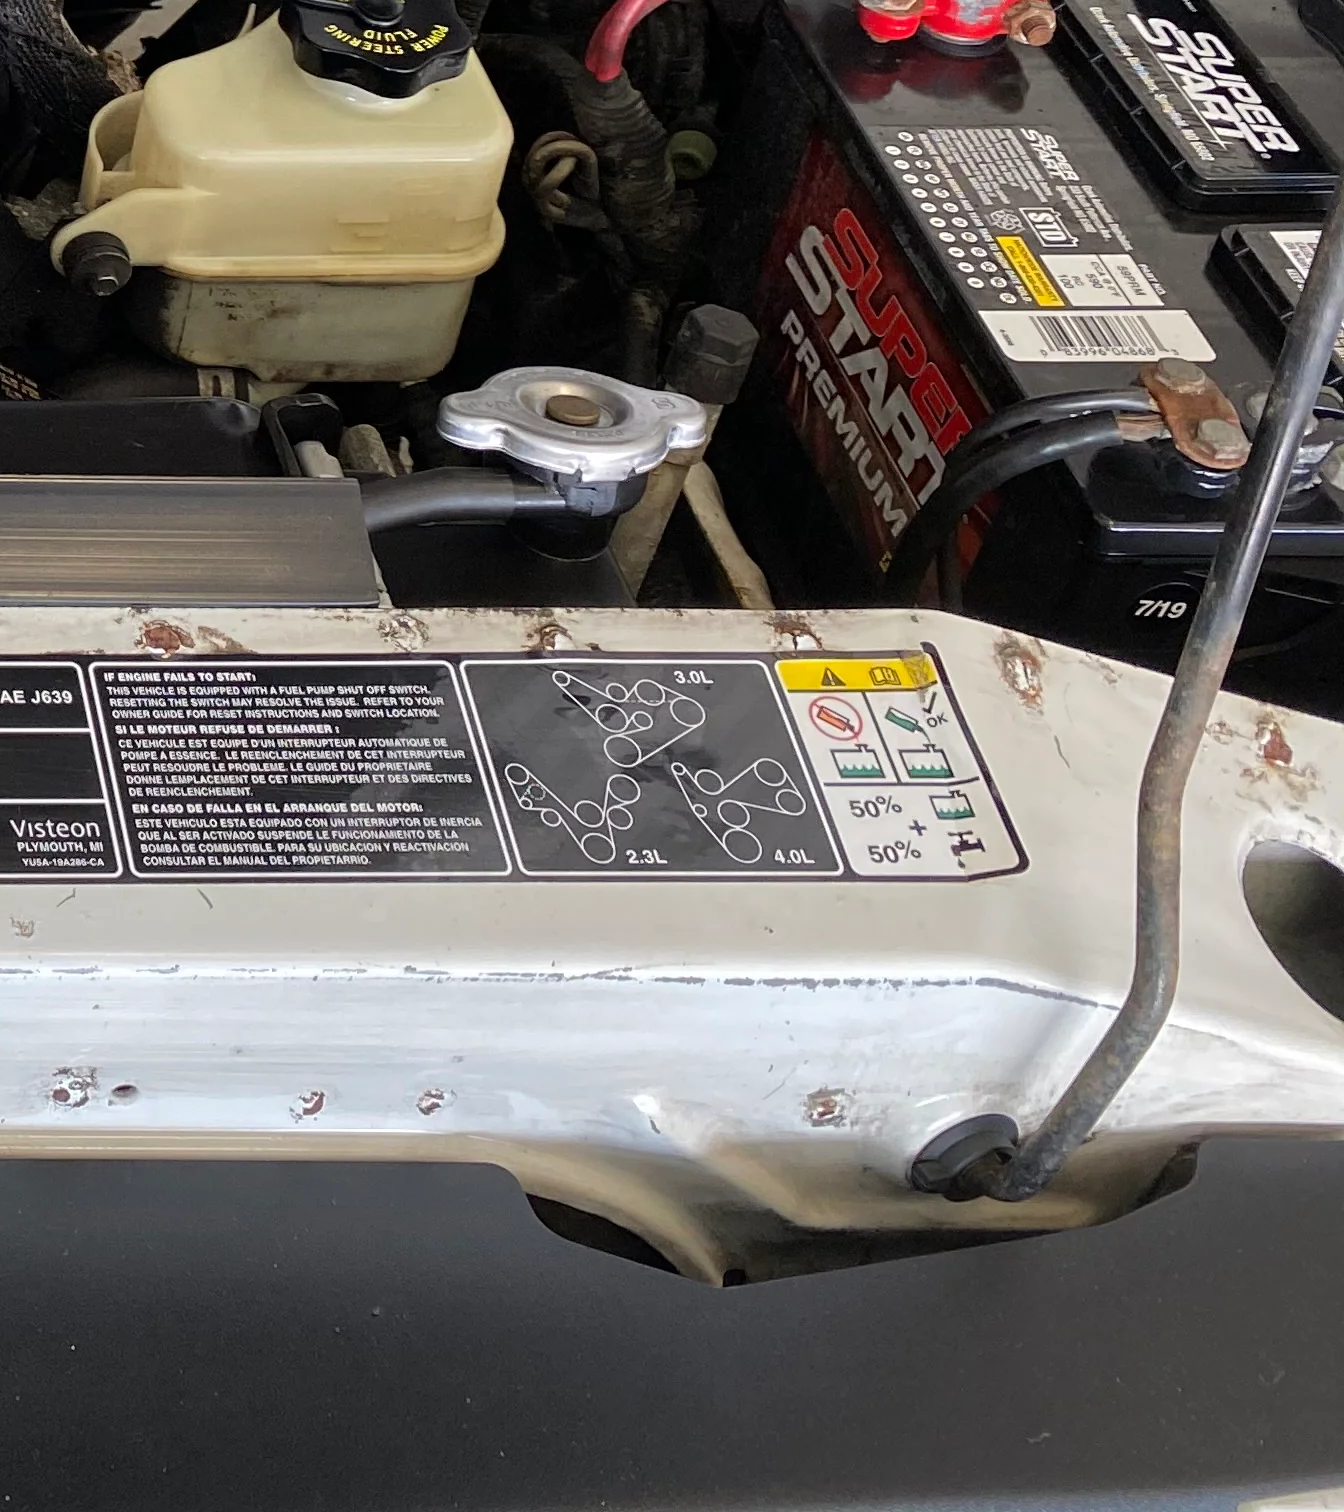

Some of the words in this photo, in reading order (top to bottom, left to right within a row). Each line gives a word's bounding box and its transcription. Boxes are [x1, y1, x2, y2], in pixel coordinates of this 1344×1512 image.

[324, 24, 404, 55] STEERING
[363, 28, 419, 42] FLUID
[410, 24, 450, 53] POWER
[1127, 13, 1269, 153] START
[1176, 29, 1301, 153] SUPER
[1020, 127, 1064, 180] START
[1037, 132, 1080, 182] SUPER
[1030, 213, 1067, 242] STD
[1057, 274, 1074, 289] 100
[1085, 273, 1104, 289] 590
[785, 225, 946, 507] START
[780, 309, 909, 538] PREMIUM
[1134, 597, 1187, 620] 7/19
[103, 672, 114, 681] IF
[117, 672, 161, 681] ENGINE
[163, 672, 195, 681] FAILS
[197, 672, 213, 681] TO
[673, 670, 714, 685] 3.0L
[30, 690, 72, 703] J639
[927, 711, 948, 728] OK
[849, 797, 902, 818] 50%
[9, 819, 100, 837] Visteon
[16, 841, 87, 853] PLYMOUTH,
[89, 841, 103, 851] MI
[626, 850, 668, 864] 2.3L
[774, 850, 816, 864] 4.0L
[868, 840, 921, 864] 50%
